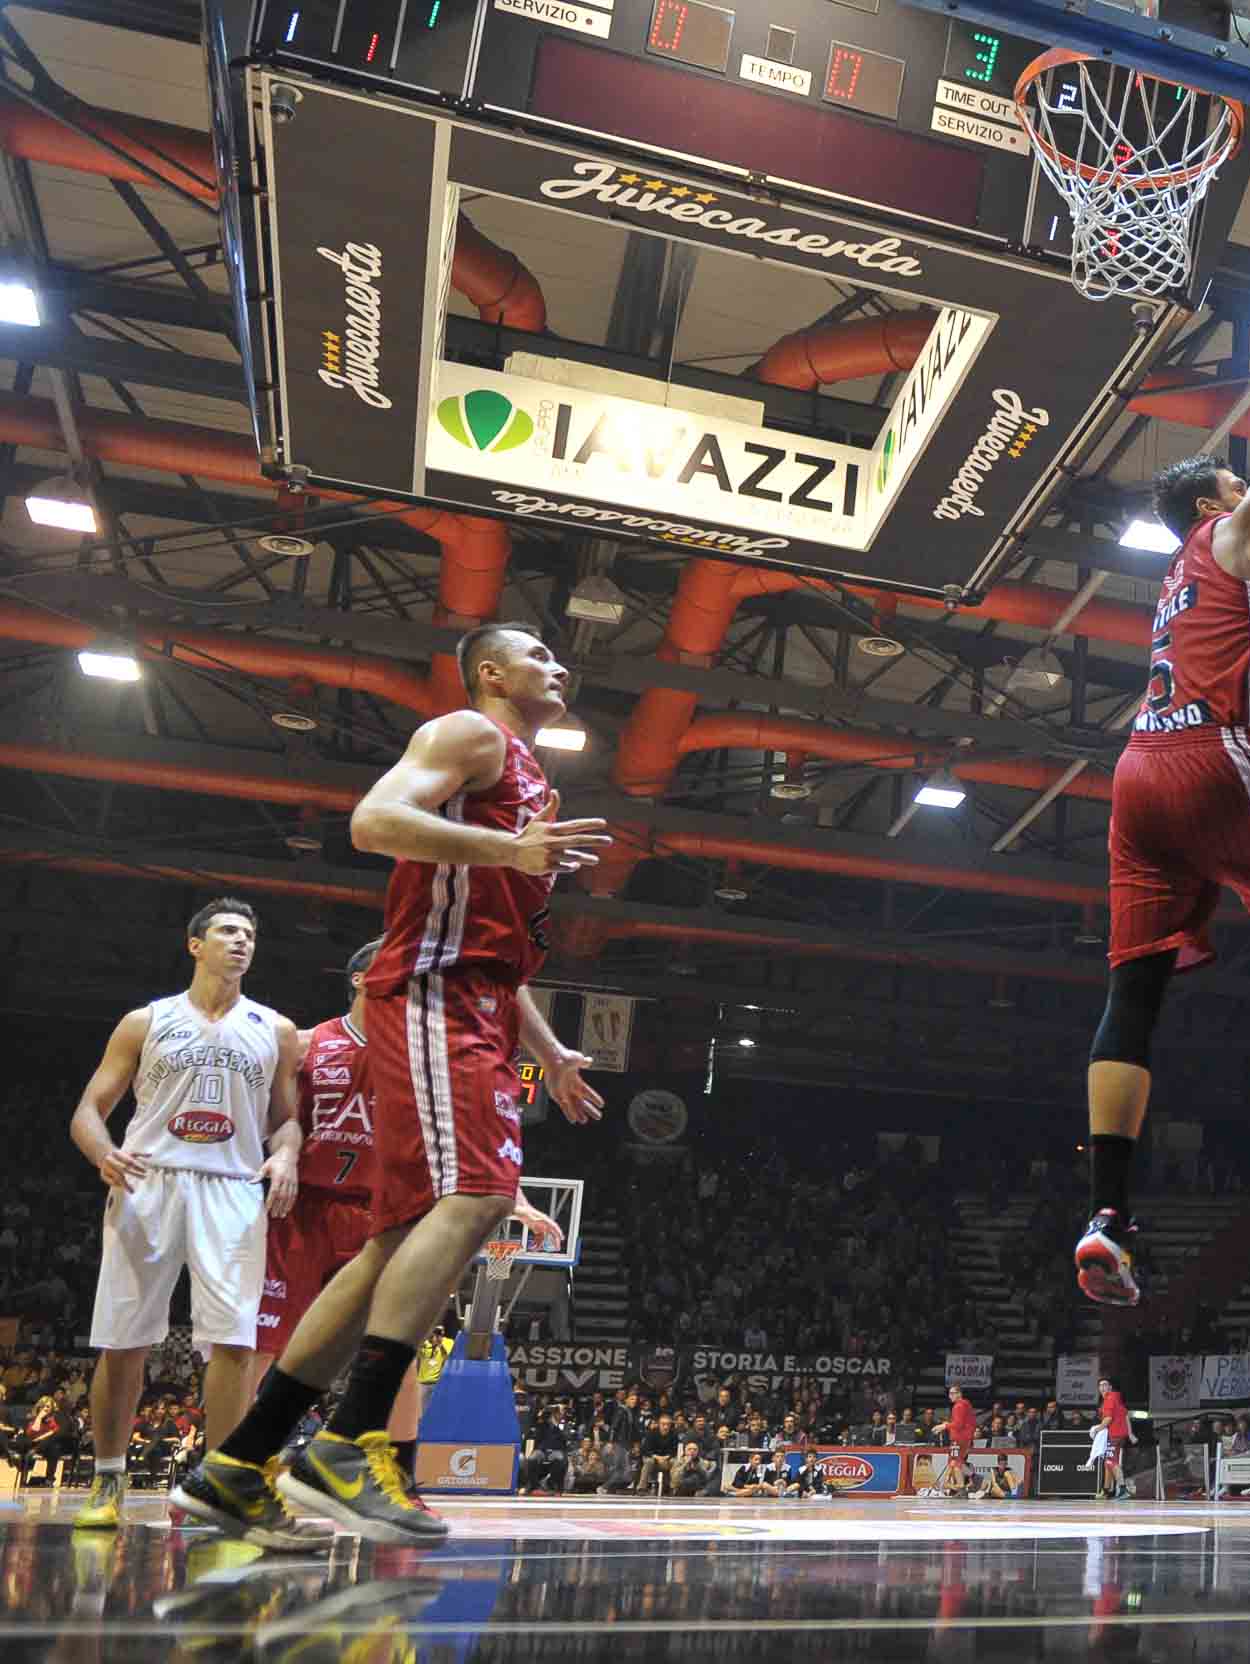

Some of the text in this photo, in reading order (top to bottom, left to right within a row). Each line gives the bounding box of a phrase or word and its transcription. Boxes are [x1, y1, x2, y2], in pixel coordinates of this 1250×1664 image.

[965, 33, 999, 82] 3
[749, 61, 805, 89] TEMPO
[942, 87, 1011, 117] TIME OUT
[1057, 83, 1078, 110] 2
[937, 114, 1004, 143] SERVIZIO
[540, 160, 923, 278] Juvecaserta
[317, 241, 392, 409] Juvecaserta
[551, 403, 859, 517] IAAZZI
[932, 388, 1050, 521] Juvecaserta
[491, 488, 792, 556] Juvecaserta
[191, 1072, 224, 1104] 10
[174, 1117, 232, 1134] REGGIA
[334, 1151, 359, 1184] 7
[692, 1351, 779, 1371] STORIA
